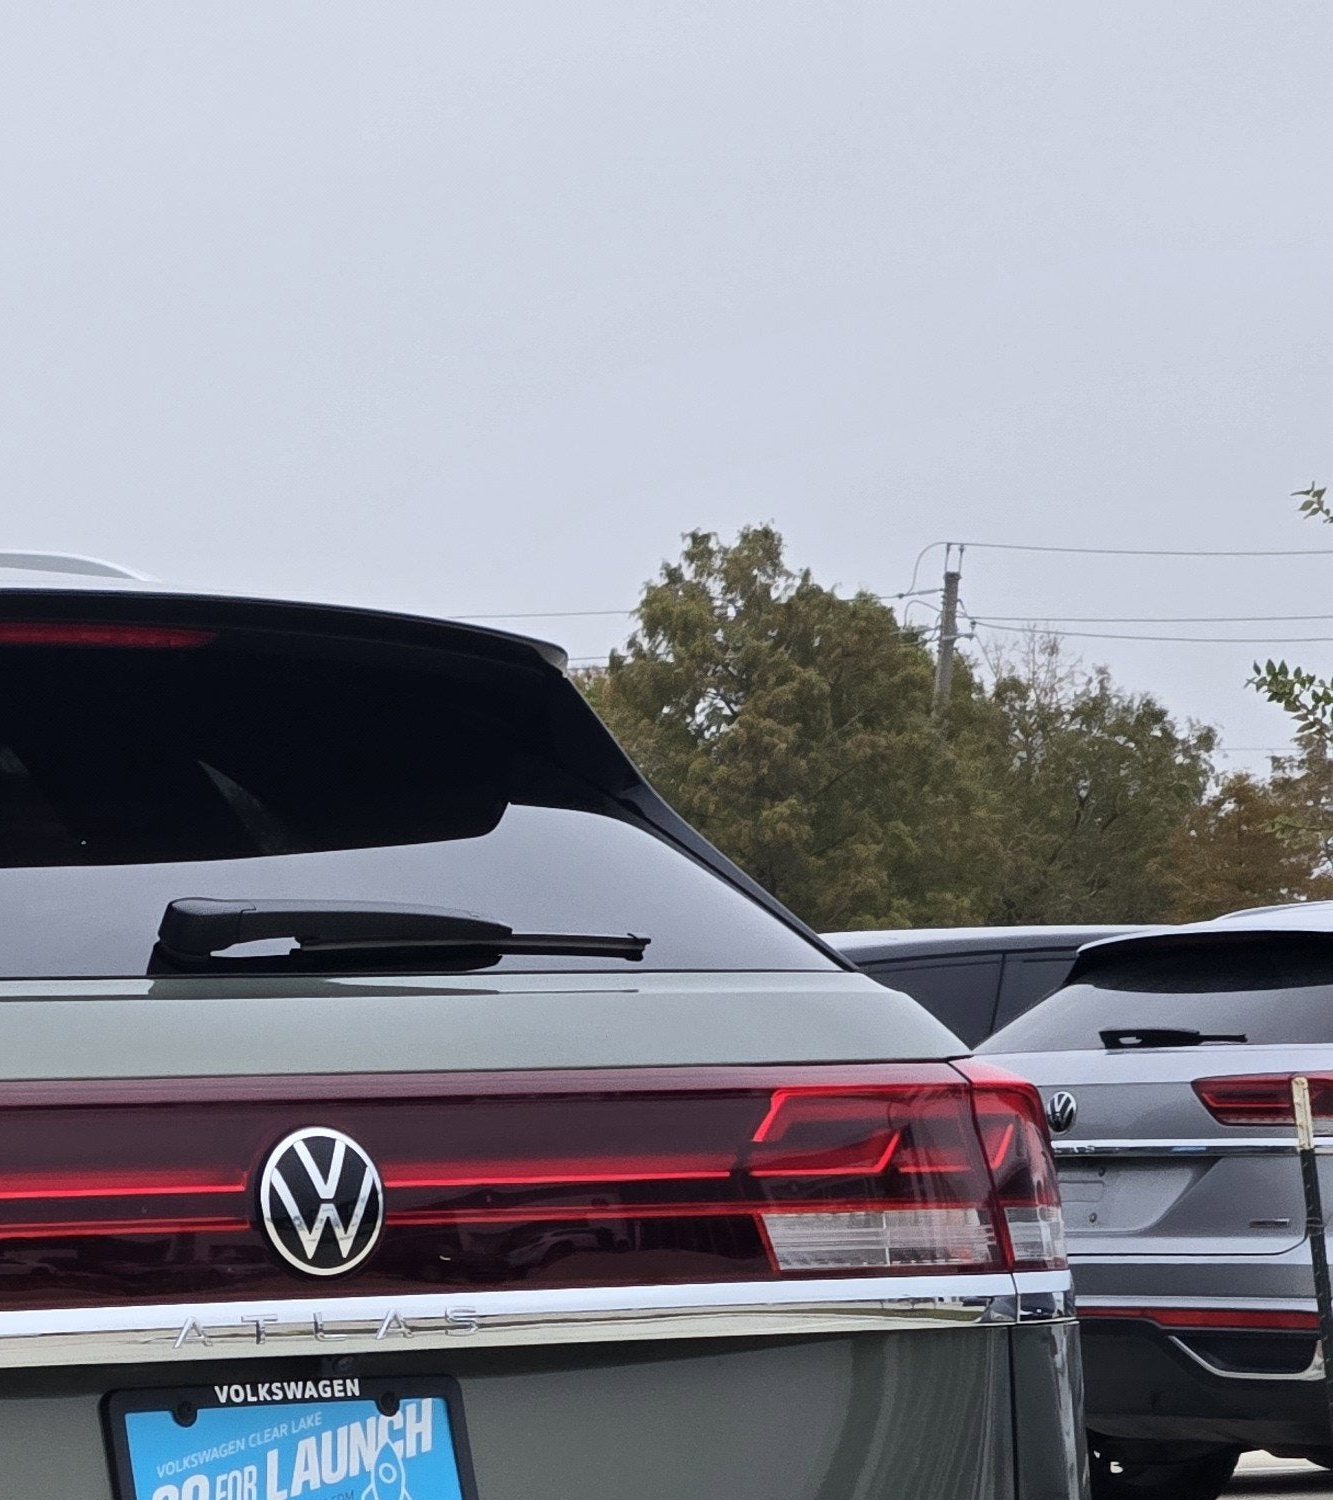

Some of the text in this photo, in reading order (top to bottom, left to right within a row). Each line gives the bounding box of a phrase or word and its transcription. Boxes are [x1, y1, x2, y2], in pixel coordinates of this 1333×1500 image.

[260, 1126, 384, 1276] VW
[173, 1306, 479, 1349] ATLAS
[214, 1377, 361, 1404] VOLKSWAGEN
[156, 1411, 323, 1478] VOLKSWAGEN CLEAR LAKE
